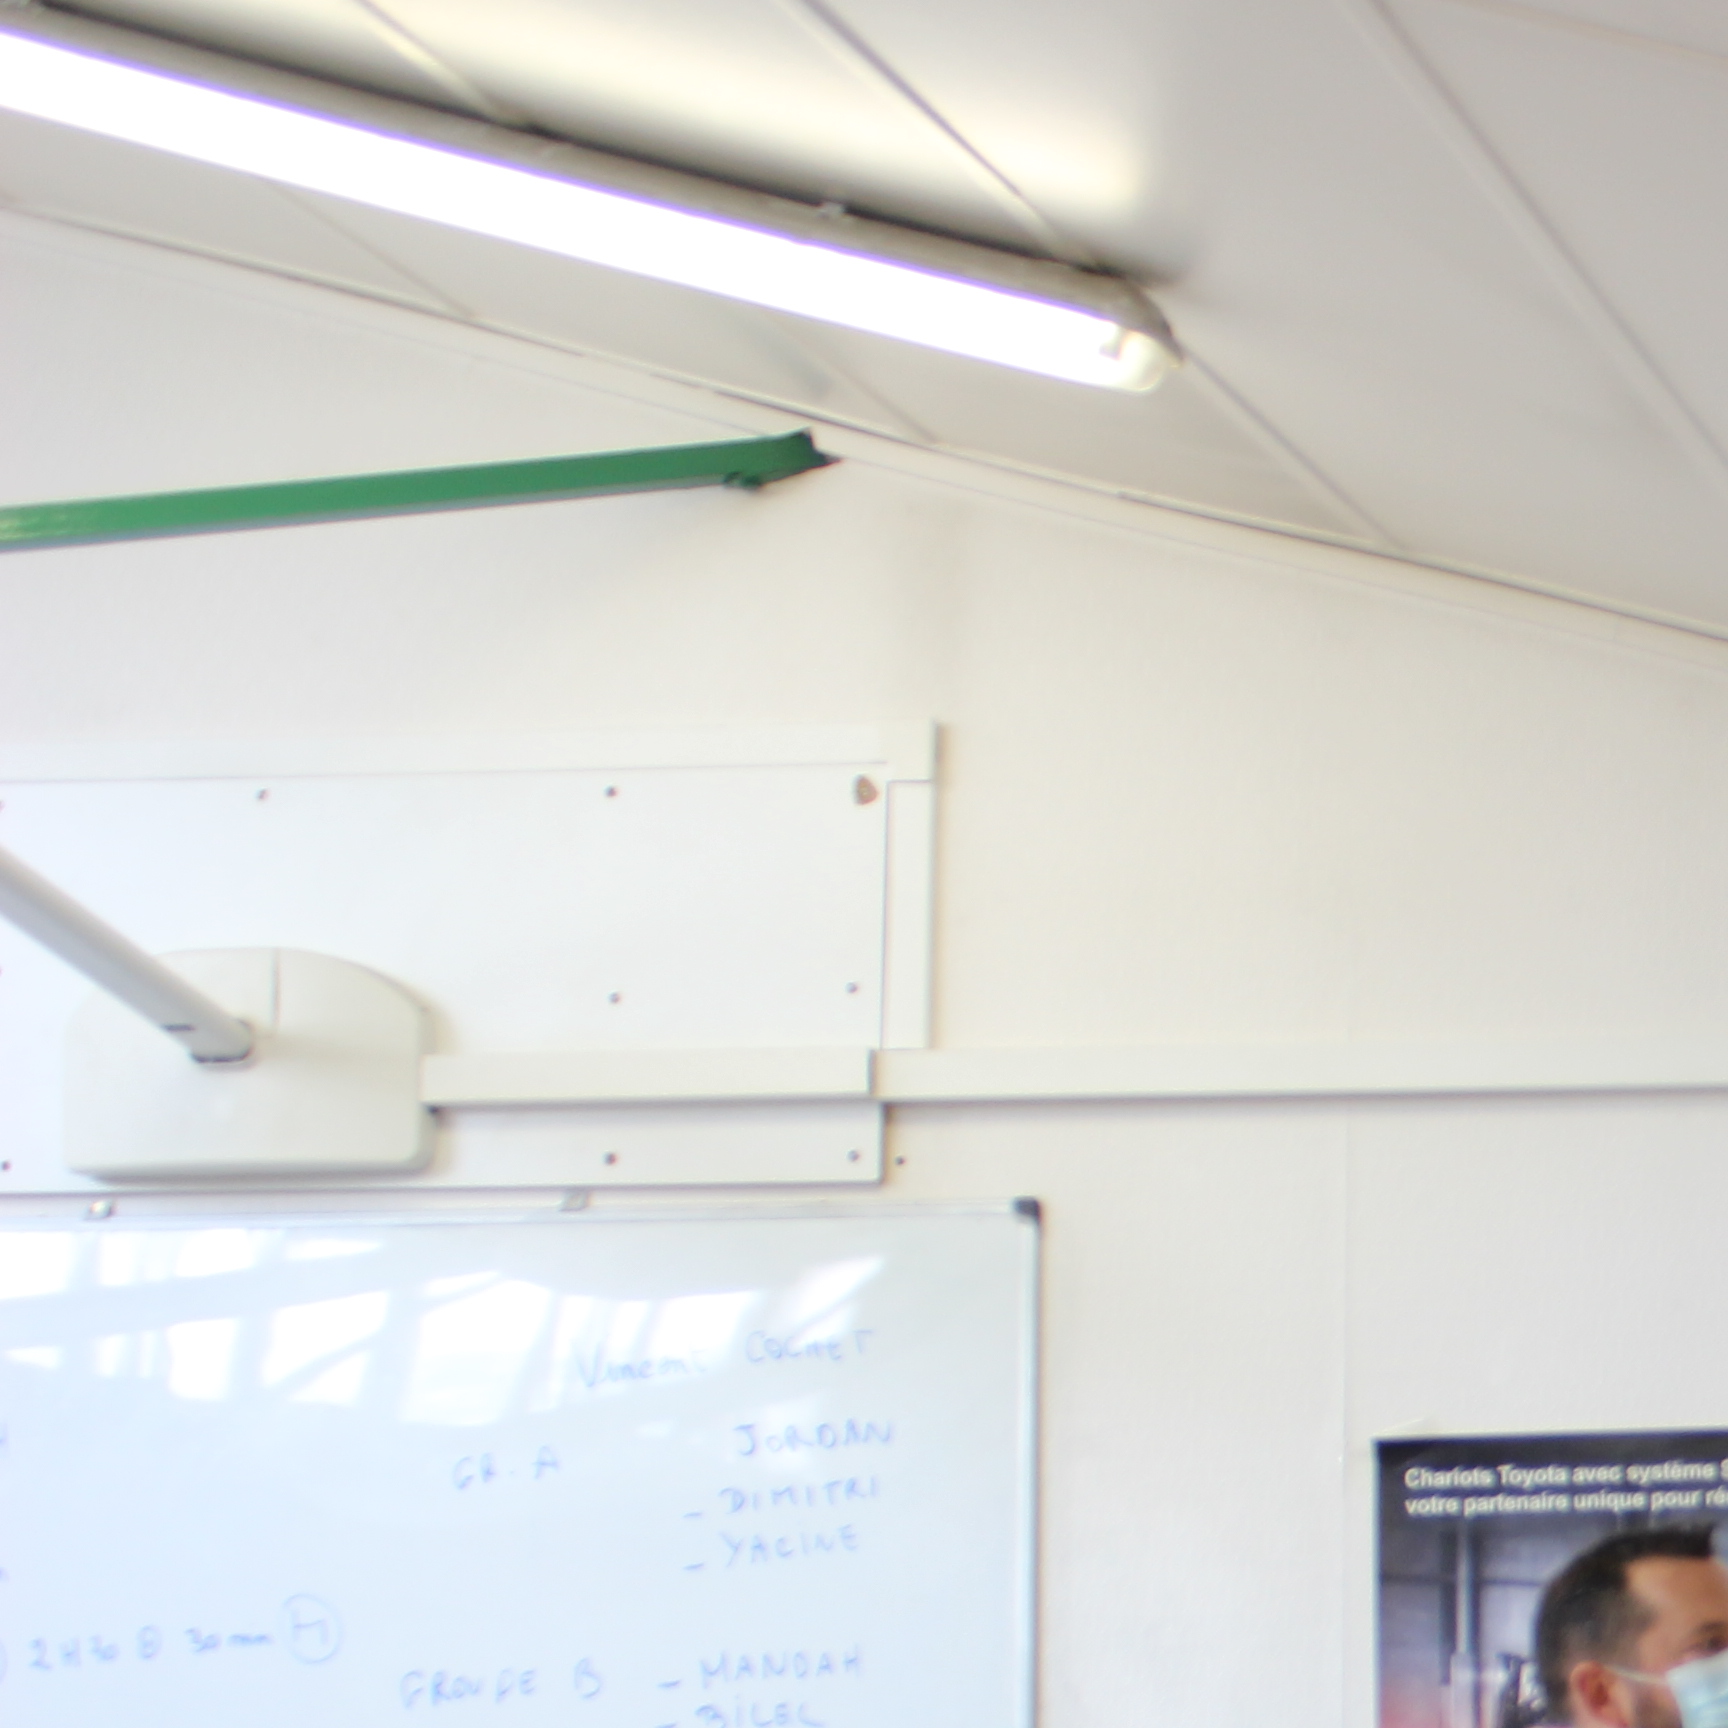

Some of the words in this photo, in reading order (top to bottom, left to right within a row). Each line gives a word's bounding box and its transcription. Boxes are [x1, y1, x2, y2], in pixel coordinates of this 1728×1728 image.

[1403, 1464, 1492, 1490] Chariots
[1496, 1463, 1569, 1490] Toyota
[1572, 1463, 1622, 1485] avec
[1626, 1458, 1714, 1486] système
[718, 1474, 881, 1514] DIMITRI
[1404, 1495, 1460, 1517] votre
[1464, 1490, 1570, 1518] partenaire
[1573, 1488, 1648, 1515] unique
[1650, 1489, 1702, 1514] pour
[718, 1523, 860, 1568] YACINE
